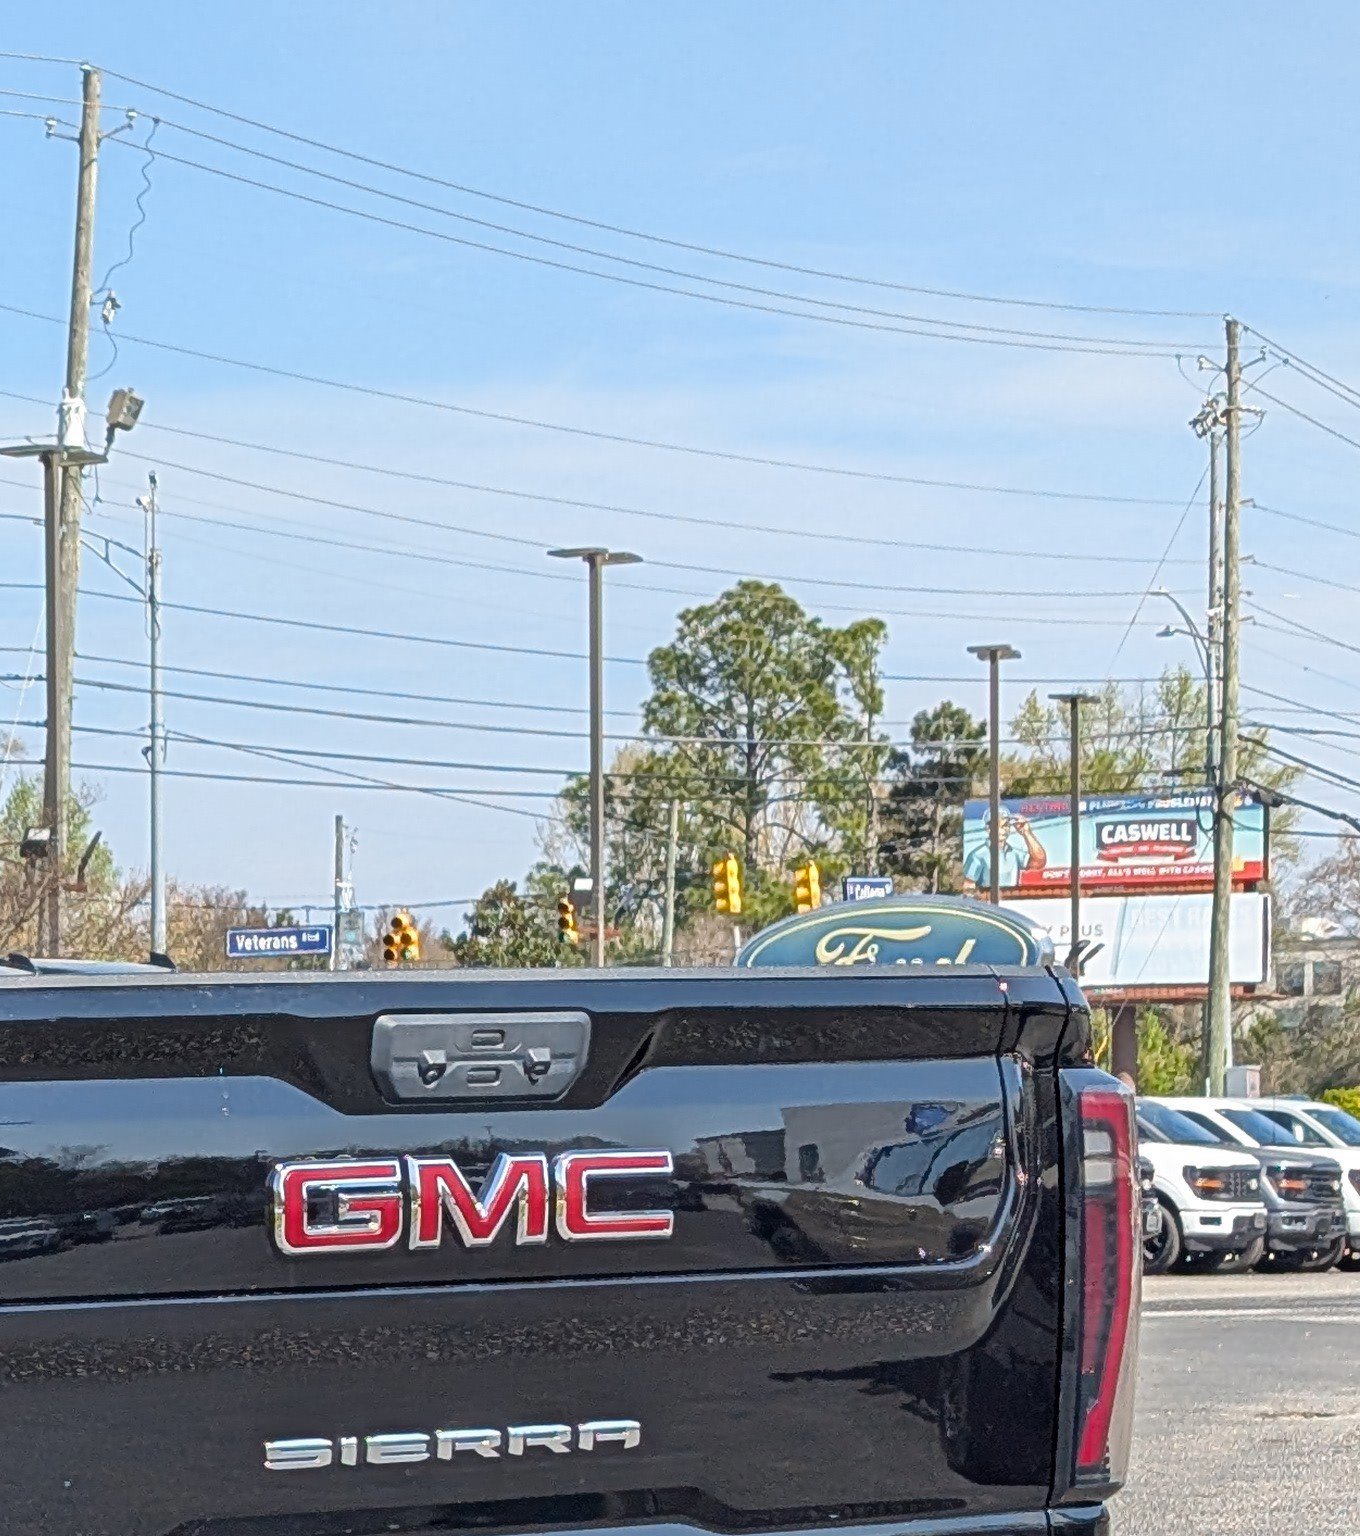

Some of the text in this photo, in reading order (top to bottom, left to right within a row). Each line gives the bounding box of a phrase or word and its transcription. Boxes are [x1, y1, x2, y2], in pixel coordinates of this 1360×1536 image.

[1101, 823, 1192, 844] CASWELL
[1060, 924, 1104, 937] PUS
[236, 934, 298, 951] Veterans
[274, 1150, 674, 1255] GMC
[264, 1420, 641, 1470] SIERRA
